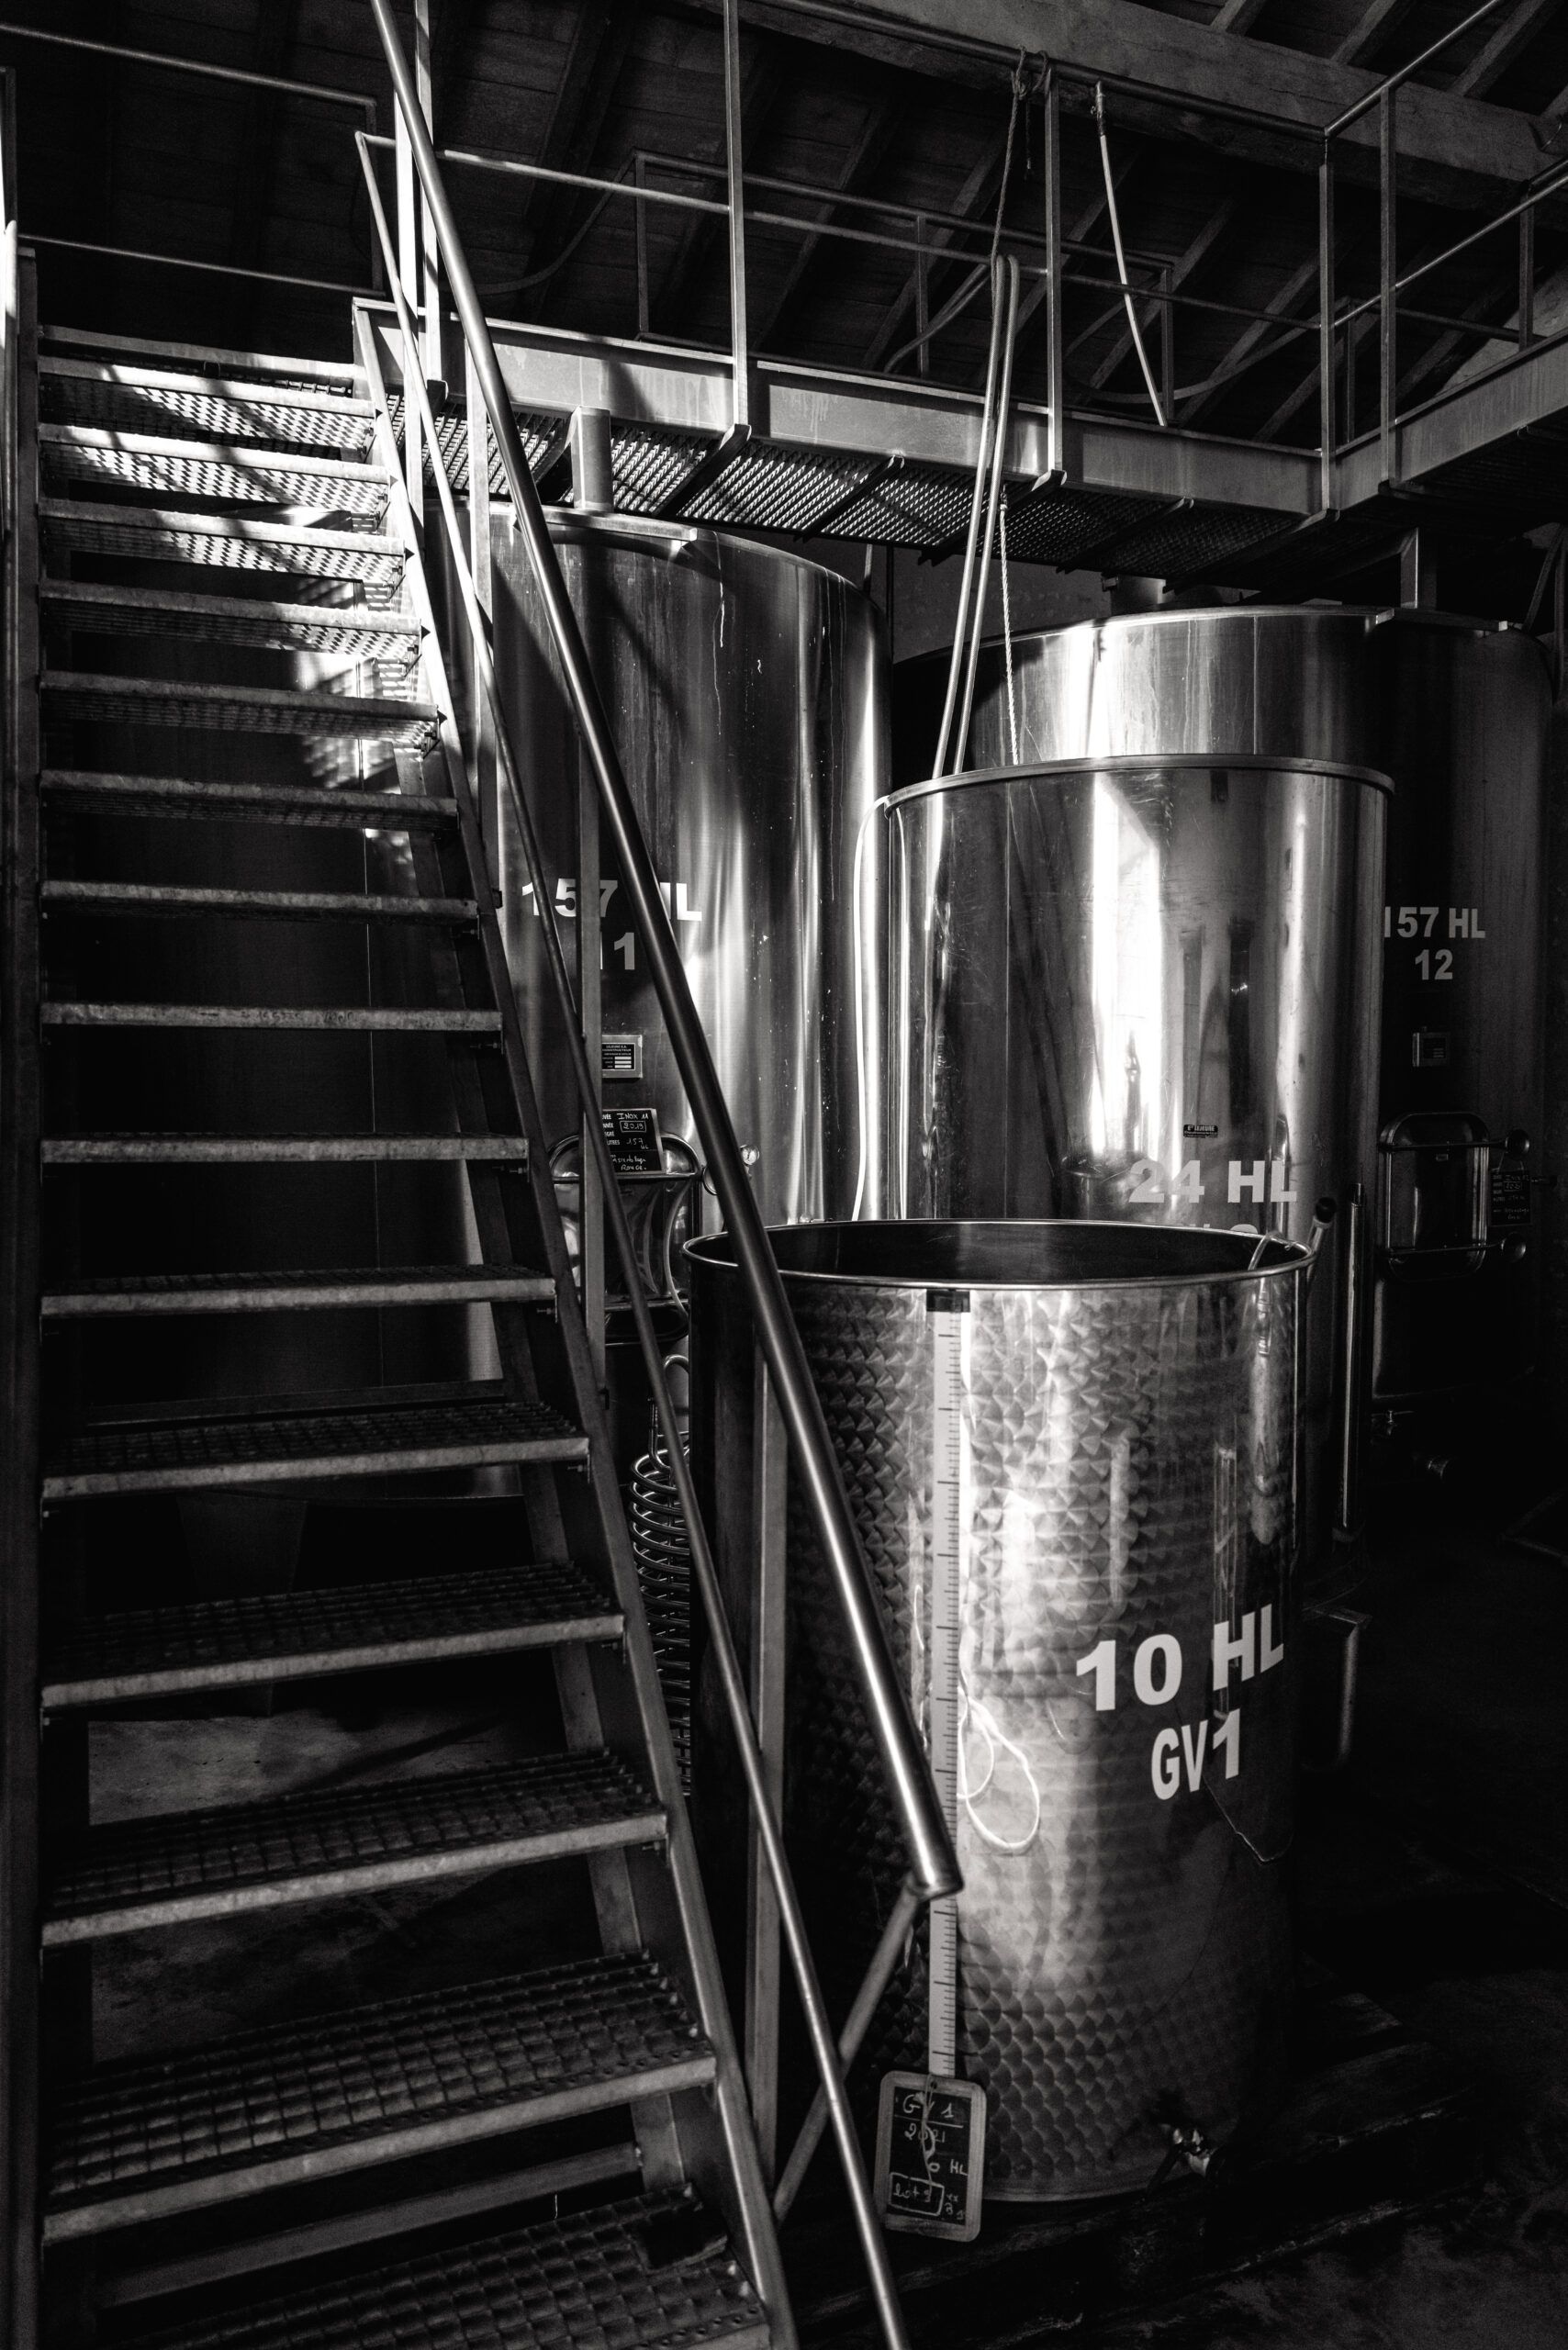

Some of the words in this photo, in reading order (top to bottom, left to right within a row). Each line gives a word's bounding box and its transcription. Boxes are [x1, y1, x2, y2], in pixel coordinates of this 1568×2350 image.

[522, 878, 619, 918] 157
[1384, 906, 1439, 938] 157
[1448, 907, 1486, 939] HL
[599, 932, 635, 970] 1
[1415, 948, 1453, 980] 12
[1128, 1159, 1205, 1203] 24
[1227, 1159, 1297, 1203] HL
[1076, 1633, 1182, 1711] 10
[1212, 1603, 1284, 1692] HL
[1150, 1707, 1240, 1800] GV1
[949, 2158, 969, 2177] HL
